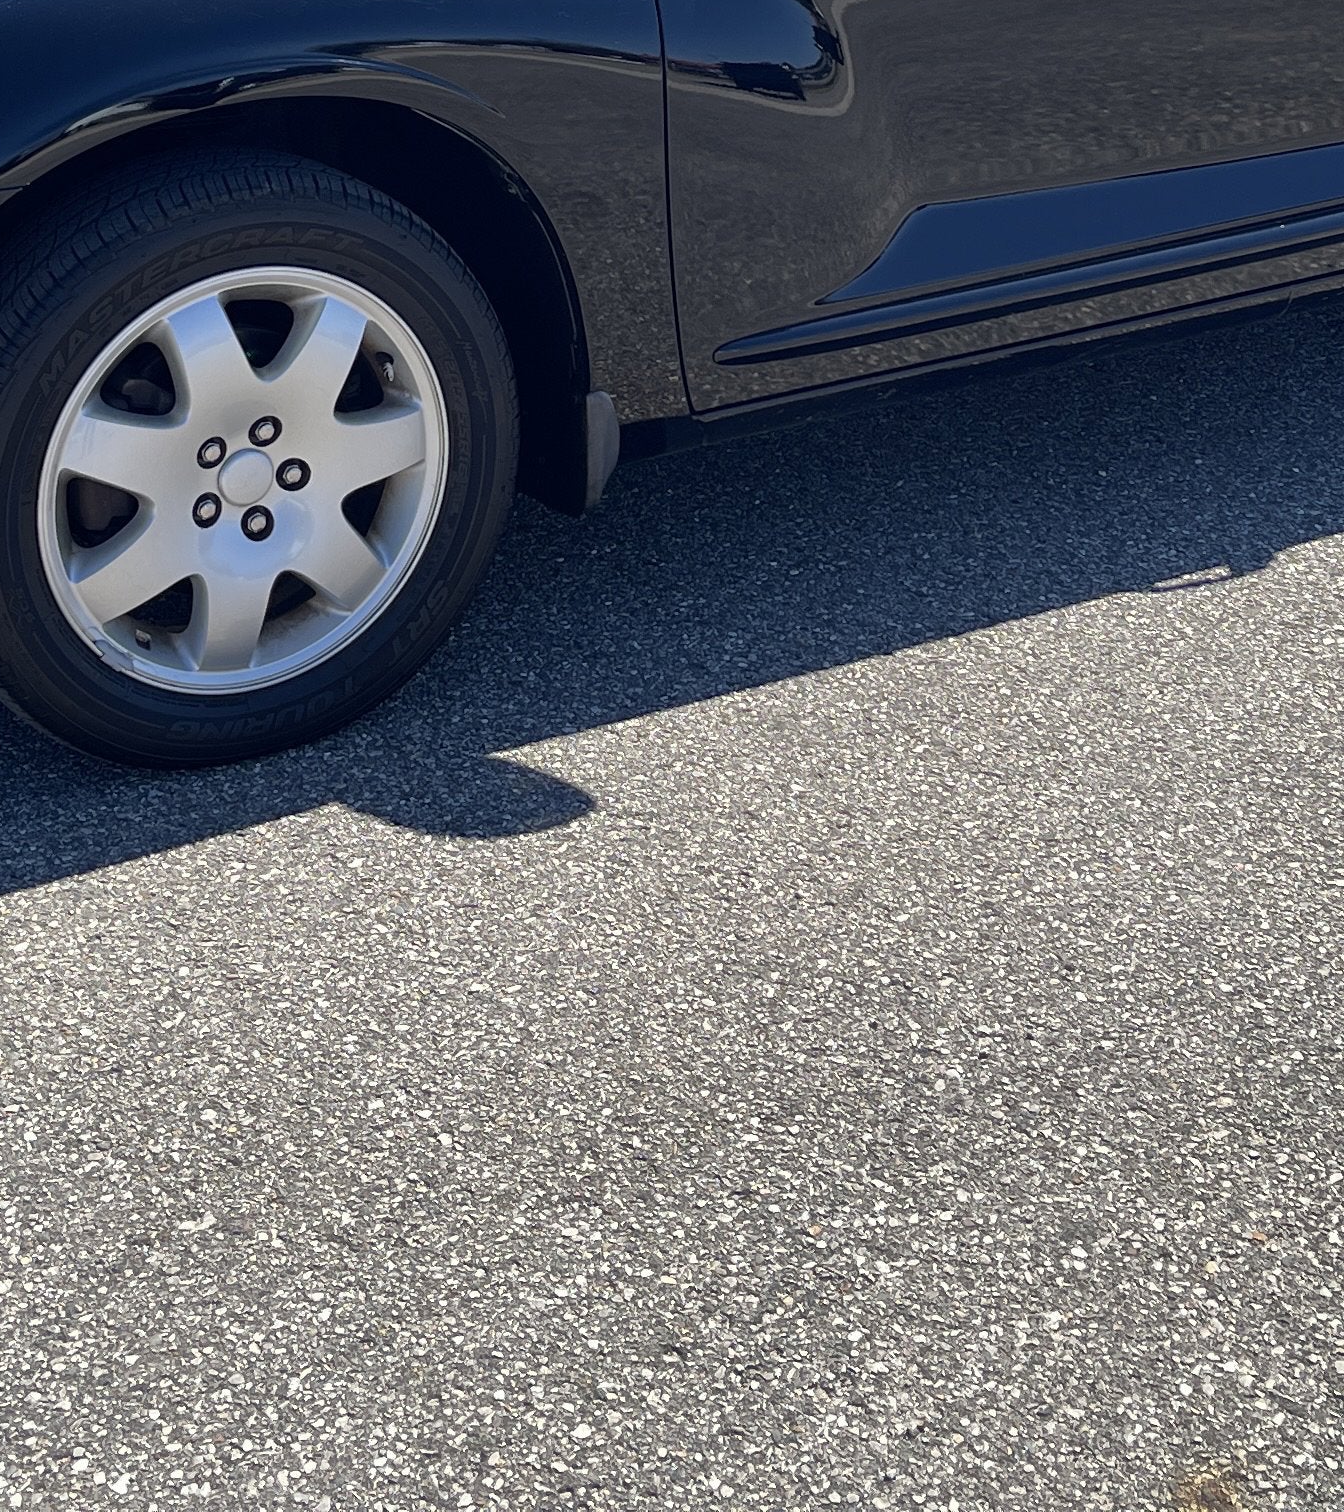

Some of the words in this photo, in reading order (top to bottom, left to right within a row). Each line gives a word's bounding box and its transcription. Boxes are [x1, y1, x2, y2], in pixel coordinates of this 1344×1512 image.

[38, 226, 366, 397] MASTERCRAFT
[391, 579, 450, 659] SRT
[166, 675, 362, 742] TOURING
